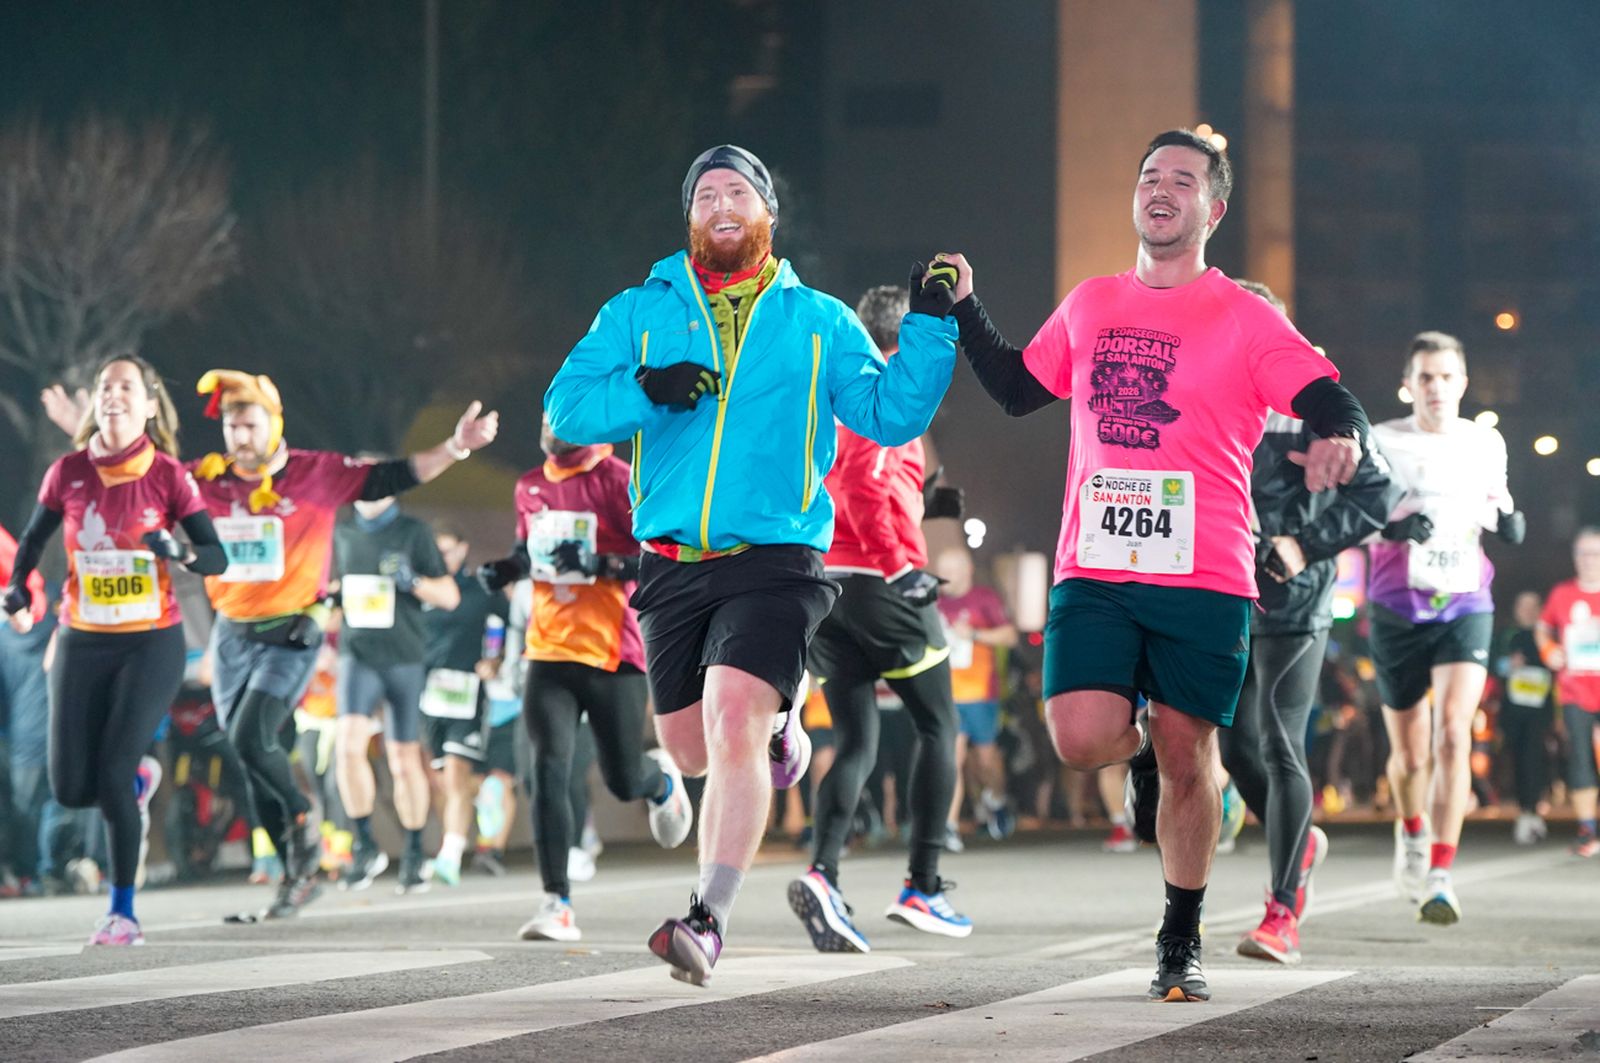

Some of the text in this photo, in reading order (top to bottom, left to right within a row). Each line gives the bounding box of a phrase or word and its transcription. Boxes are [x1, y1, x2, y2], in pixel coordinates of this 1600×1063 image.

[1114, 328, 1180, 347] CONSEGUIDO
[1096, 337, 1175, 364] DORSAL
[1106, 353, 1129, 363] SAN
[1100, 422, 1156, 447] 500€
[1092, 491, 1114, 503] SAN
[1105, 480, 1152, 493] NOCHE DE
[1101, 506, 1172, 538] 4264
[92, 575, 143, 598] 9506
